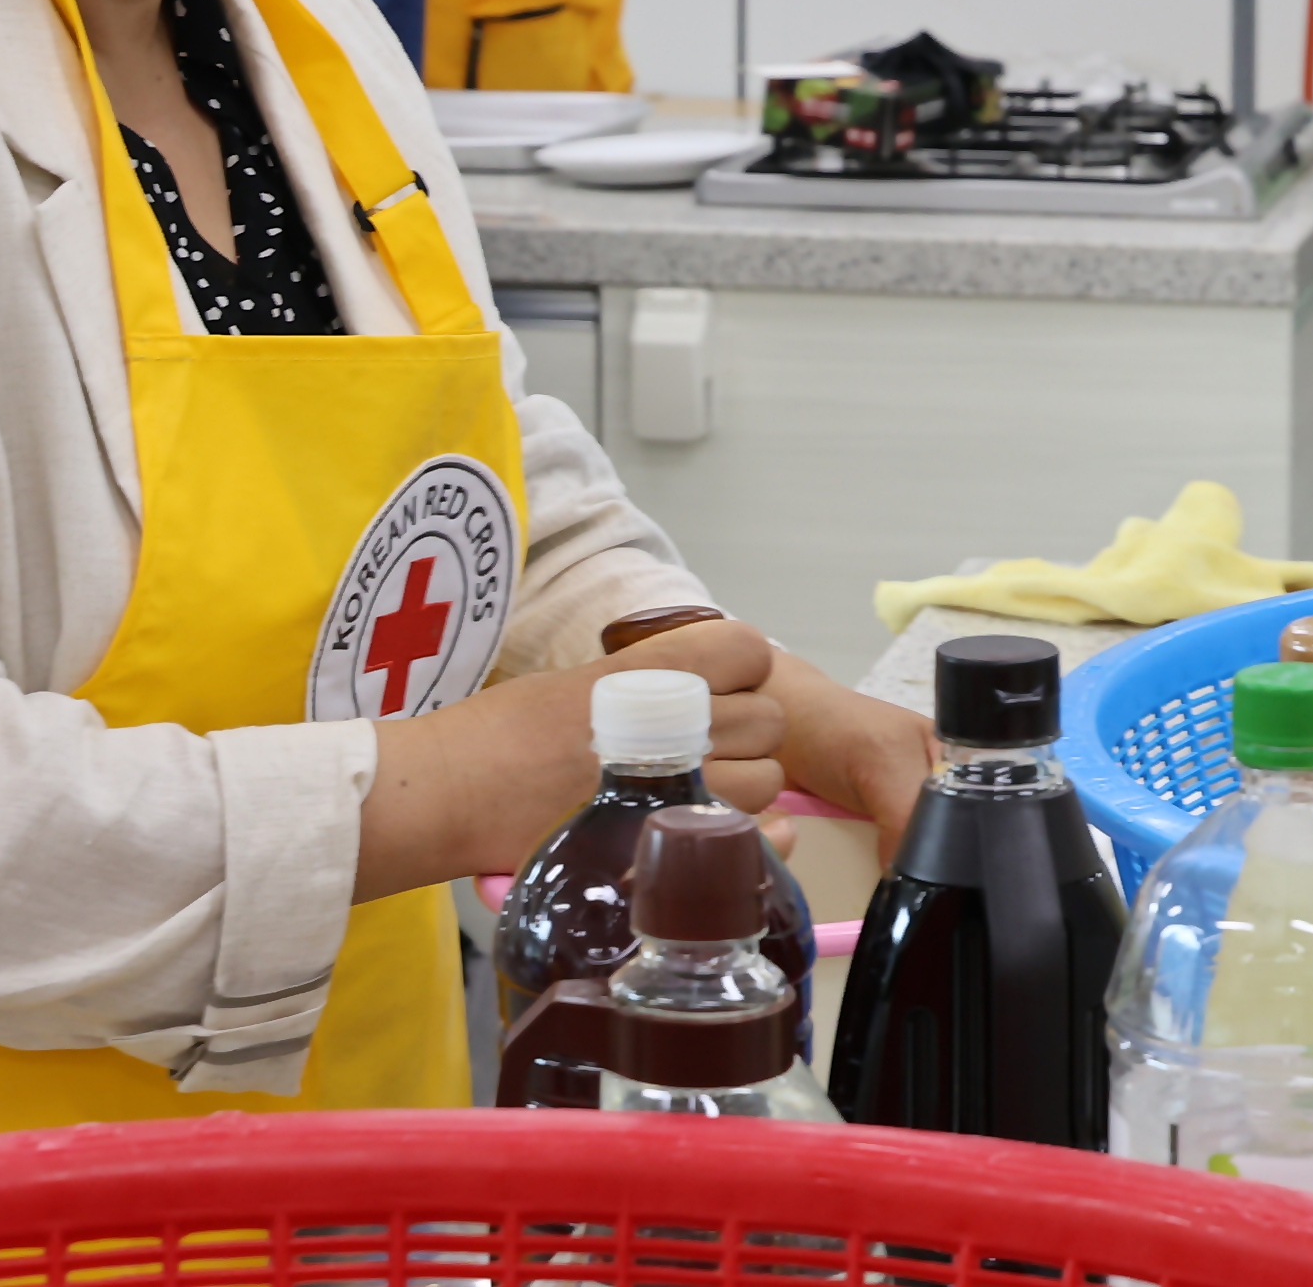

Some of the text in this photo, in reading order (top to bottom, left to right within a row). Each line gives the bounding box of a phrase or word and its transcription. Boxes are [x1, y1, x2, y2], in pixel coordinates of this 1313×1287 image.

[331, 483, 501, 651] KOREAN RED CROSS
